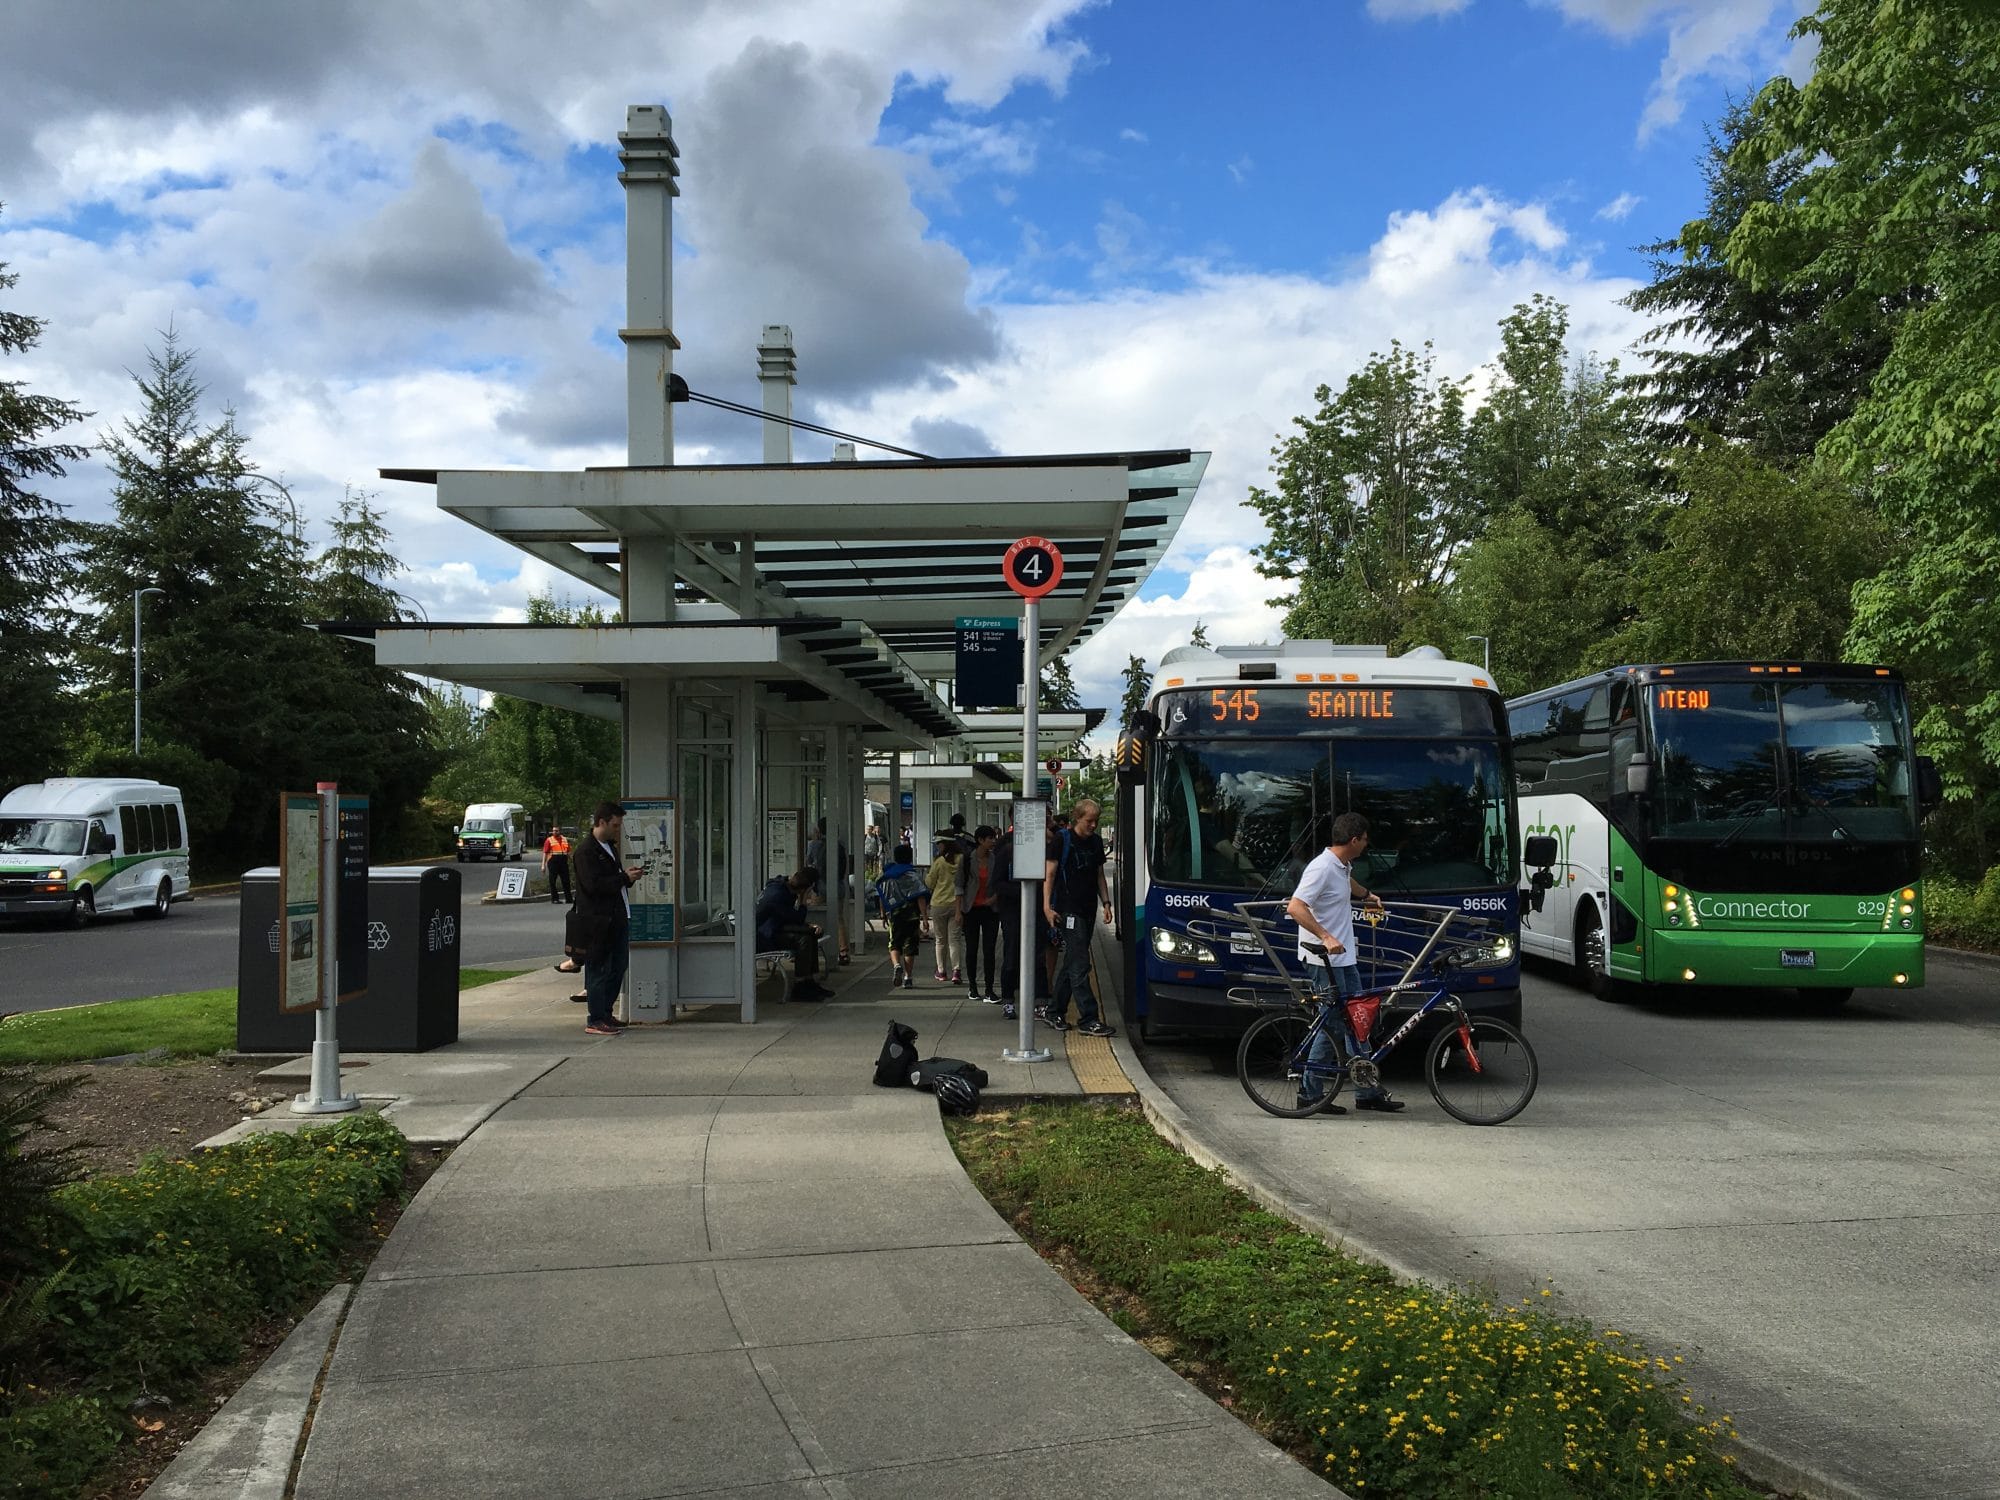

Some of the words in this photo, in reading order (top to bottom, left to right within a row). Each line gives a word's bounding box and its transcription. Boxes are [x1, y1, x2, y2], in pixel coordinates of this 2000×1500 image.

[1011, 540, 1031, 554] BUS
[1039, 539, 1058, 554] BAY
[1022, 554, 1042, 580] 4
[973, 619, 1001, 628] Express
[963, 631, 979, 641] 541
[963, 642, 980, 652] 545
[1212, 689, 1260, 721] 545
[1308, 691, 1393, 718] SEATTLE
[1051, 761, 1057, 770] 3
[507, 883, 516, 893] 5
[1165, 895, 1210, 908] 9656K
[1463, 898, 1507, 911] 9656K
[1697, 897, 1812, 918] Connector
[1857, 901, 1885, 916] 829
